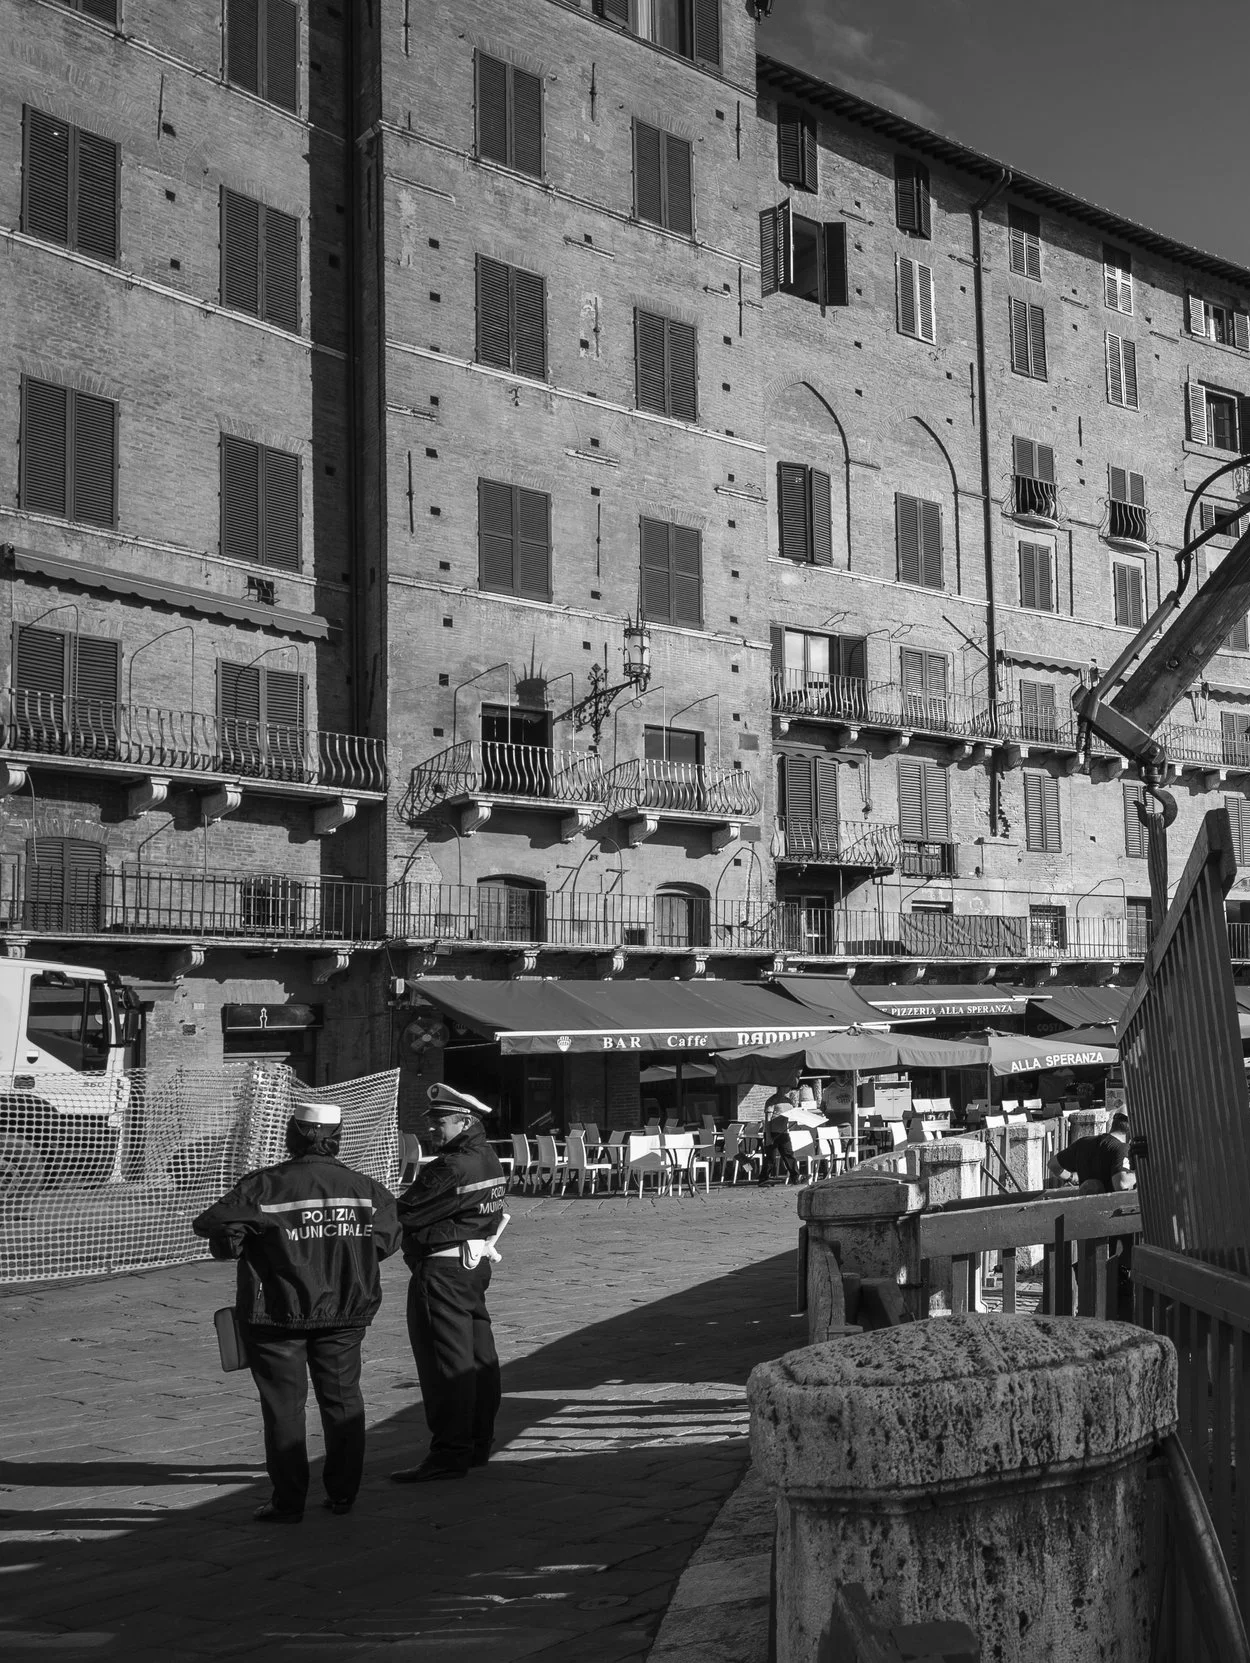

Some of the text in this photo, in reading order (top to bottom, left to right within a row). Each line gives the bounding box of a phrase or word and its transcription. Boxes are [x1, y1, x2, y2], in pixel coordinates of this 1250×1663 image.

[891, 1006, 937, 1016] PIZZERIA
[939, 1006, 964, 1015] ALLA
[966, 1004, 1013, 1014] SPERANZA
[602, 1036, 642, 1049] BAR
[1011, 1051, 1104, 1073] ALLA SPERANZA
[301, 1207, 357, 1225] POLIZIA
[285, 1223, 373, 1241] MUNICIPALE
